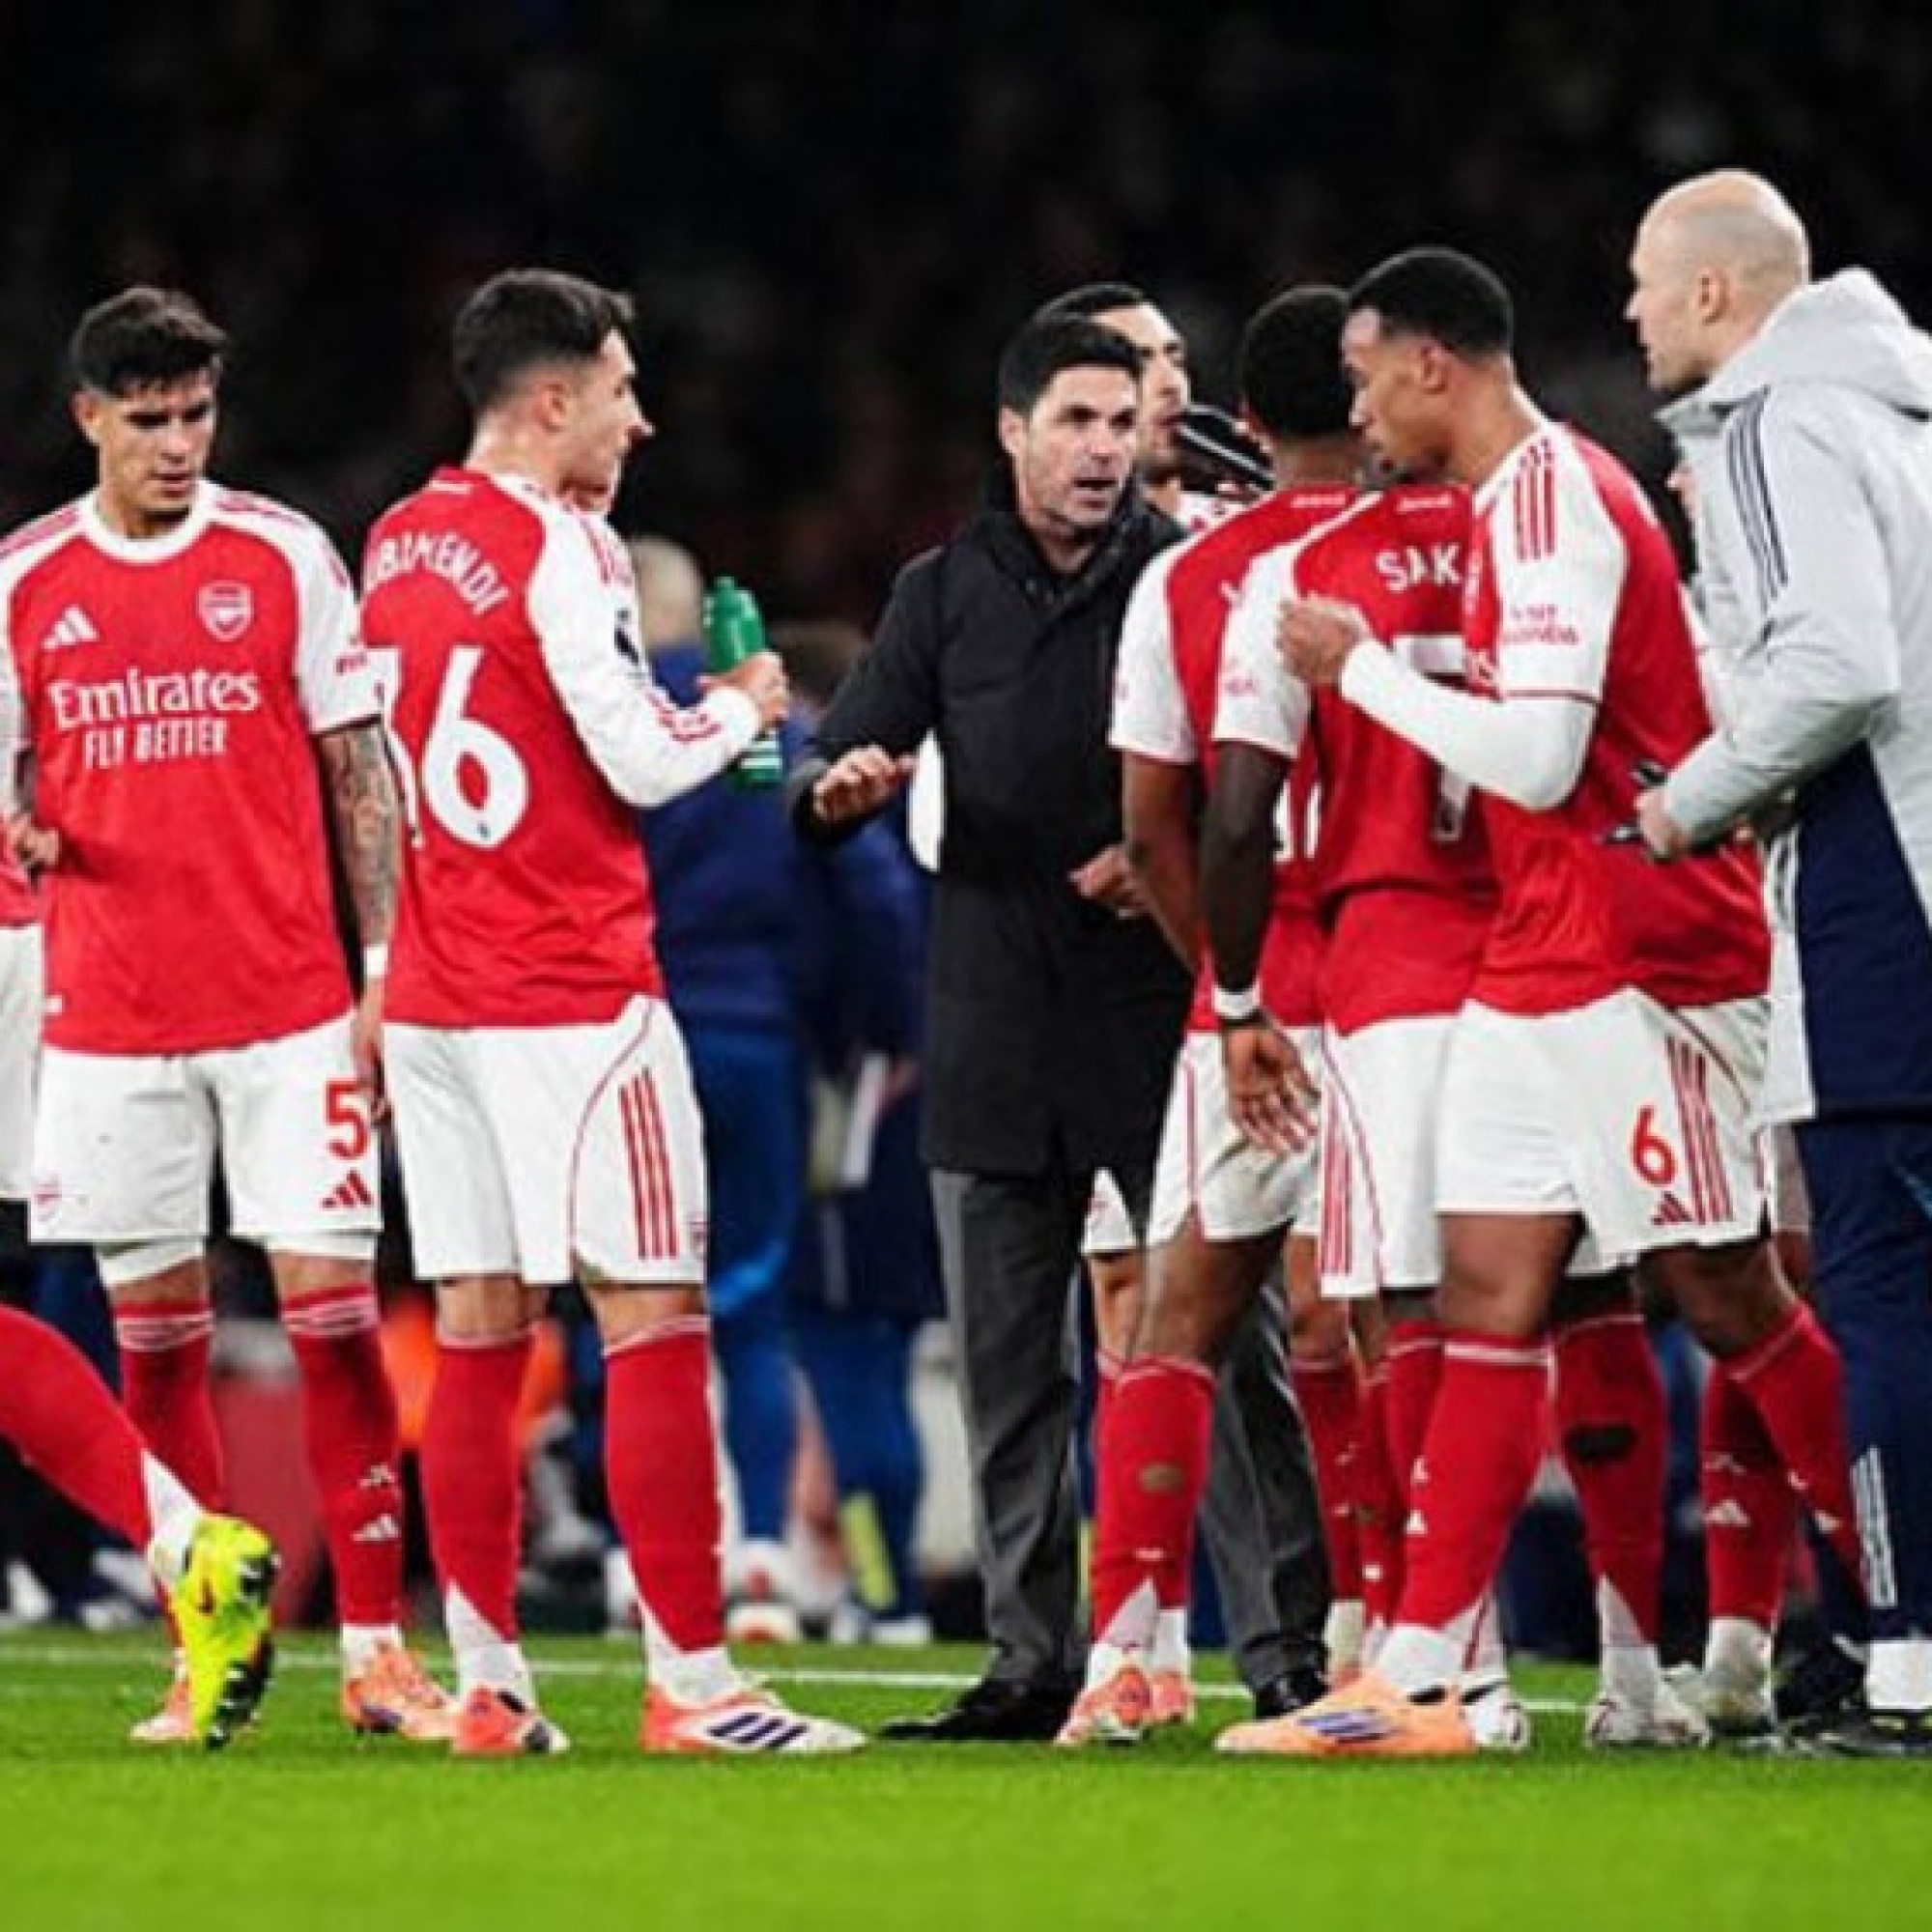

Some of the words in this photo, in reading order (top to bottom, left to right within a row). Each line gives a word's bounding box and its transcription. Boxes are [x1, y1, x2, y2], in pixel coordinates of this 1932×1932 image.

[1375, 545, 1462, 593] SAK
[50, 666, 262, 729] Emirates
[133, 715, 228, 761] BETTER
[327, 1078, 371, 1160] 5
[1632, 1104, 1677, 1186] 6
